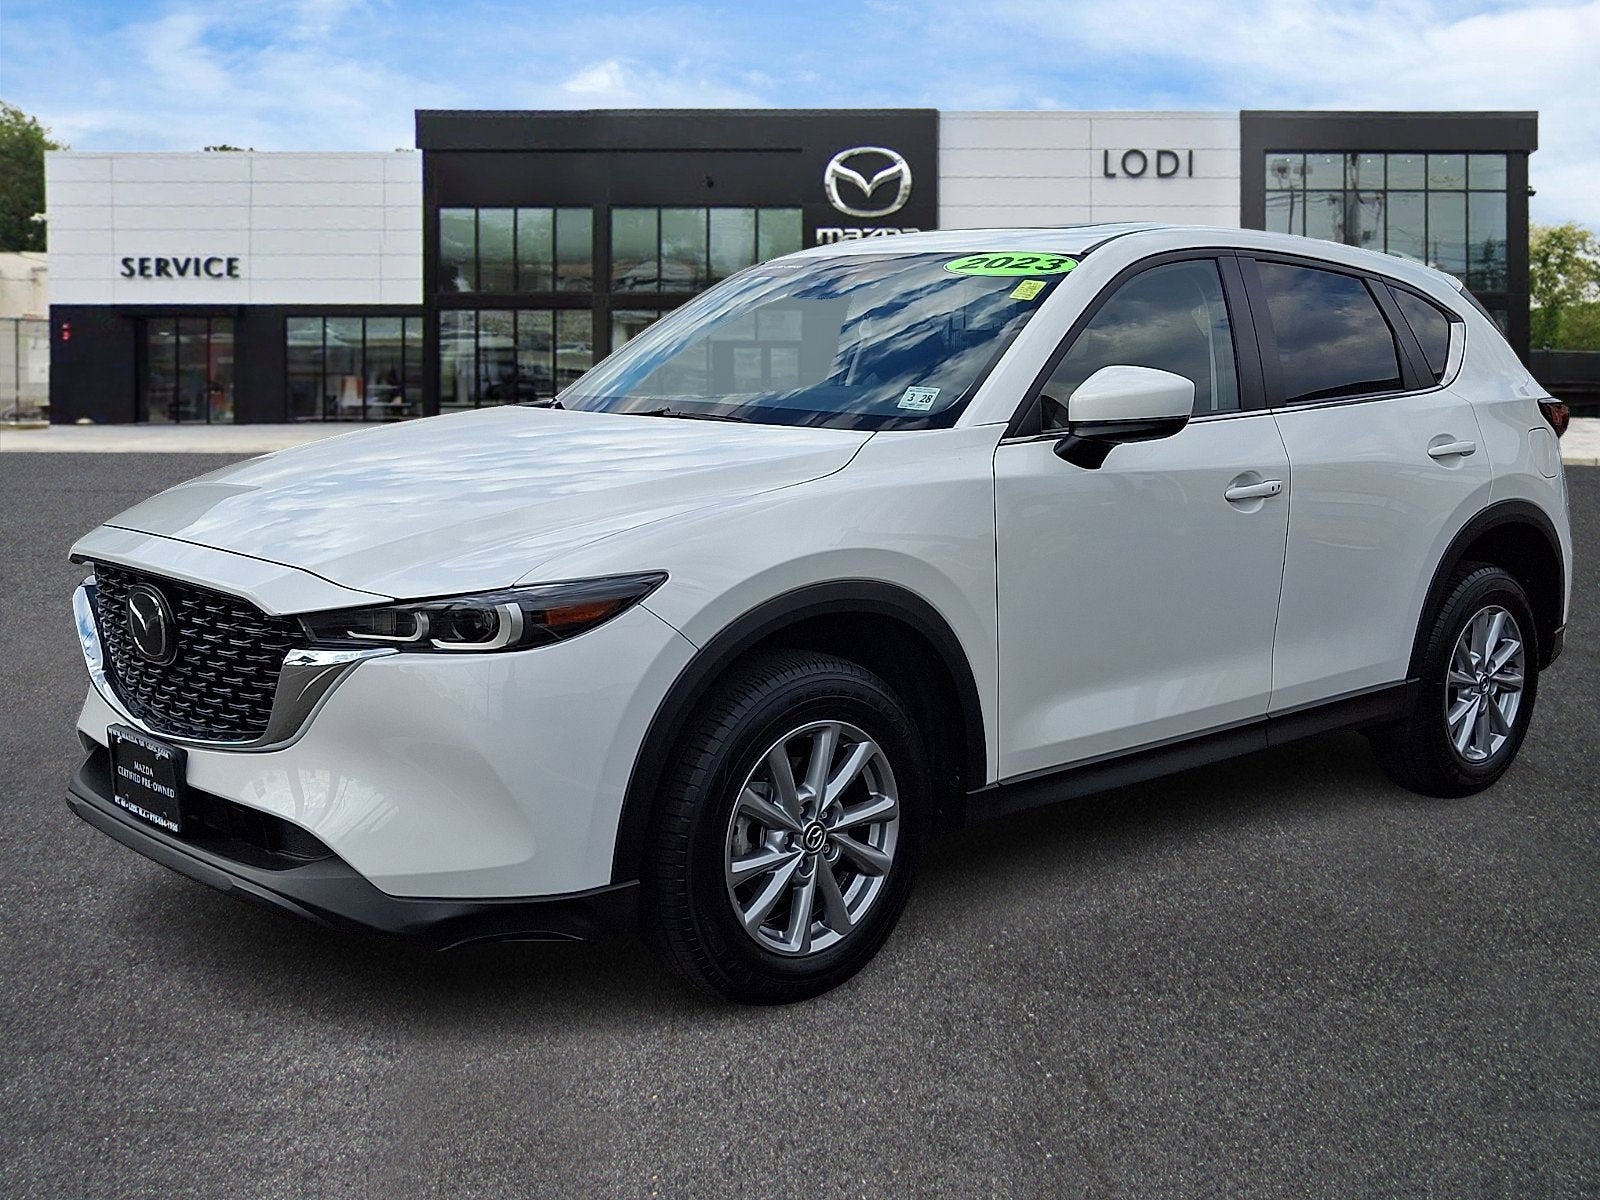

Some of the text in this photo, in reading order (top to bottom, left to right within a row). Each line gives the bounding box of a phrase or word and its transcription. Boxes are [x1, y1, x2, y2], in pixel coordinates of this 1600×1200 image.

[1103, 148, 1193, 178] LODI
[120, 256, 240, 278] SERVICE
[955, 256, 1068, 271] 2023
[906, 392, 933, 404] 3 28
[133, 760, 154, 778] MAZDA
[117, 765, 141, 784] CERTIFIED
[141, 777, 175, 799] PRE-OWNED
